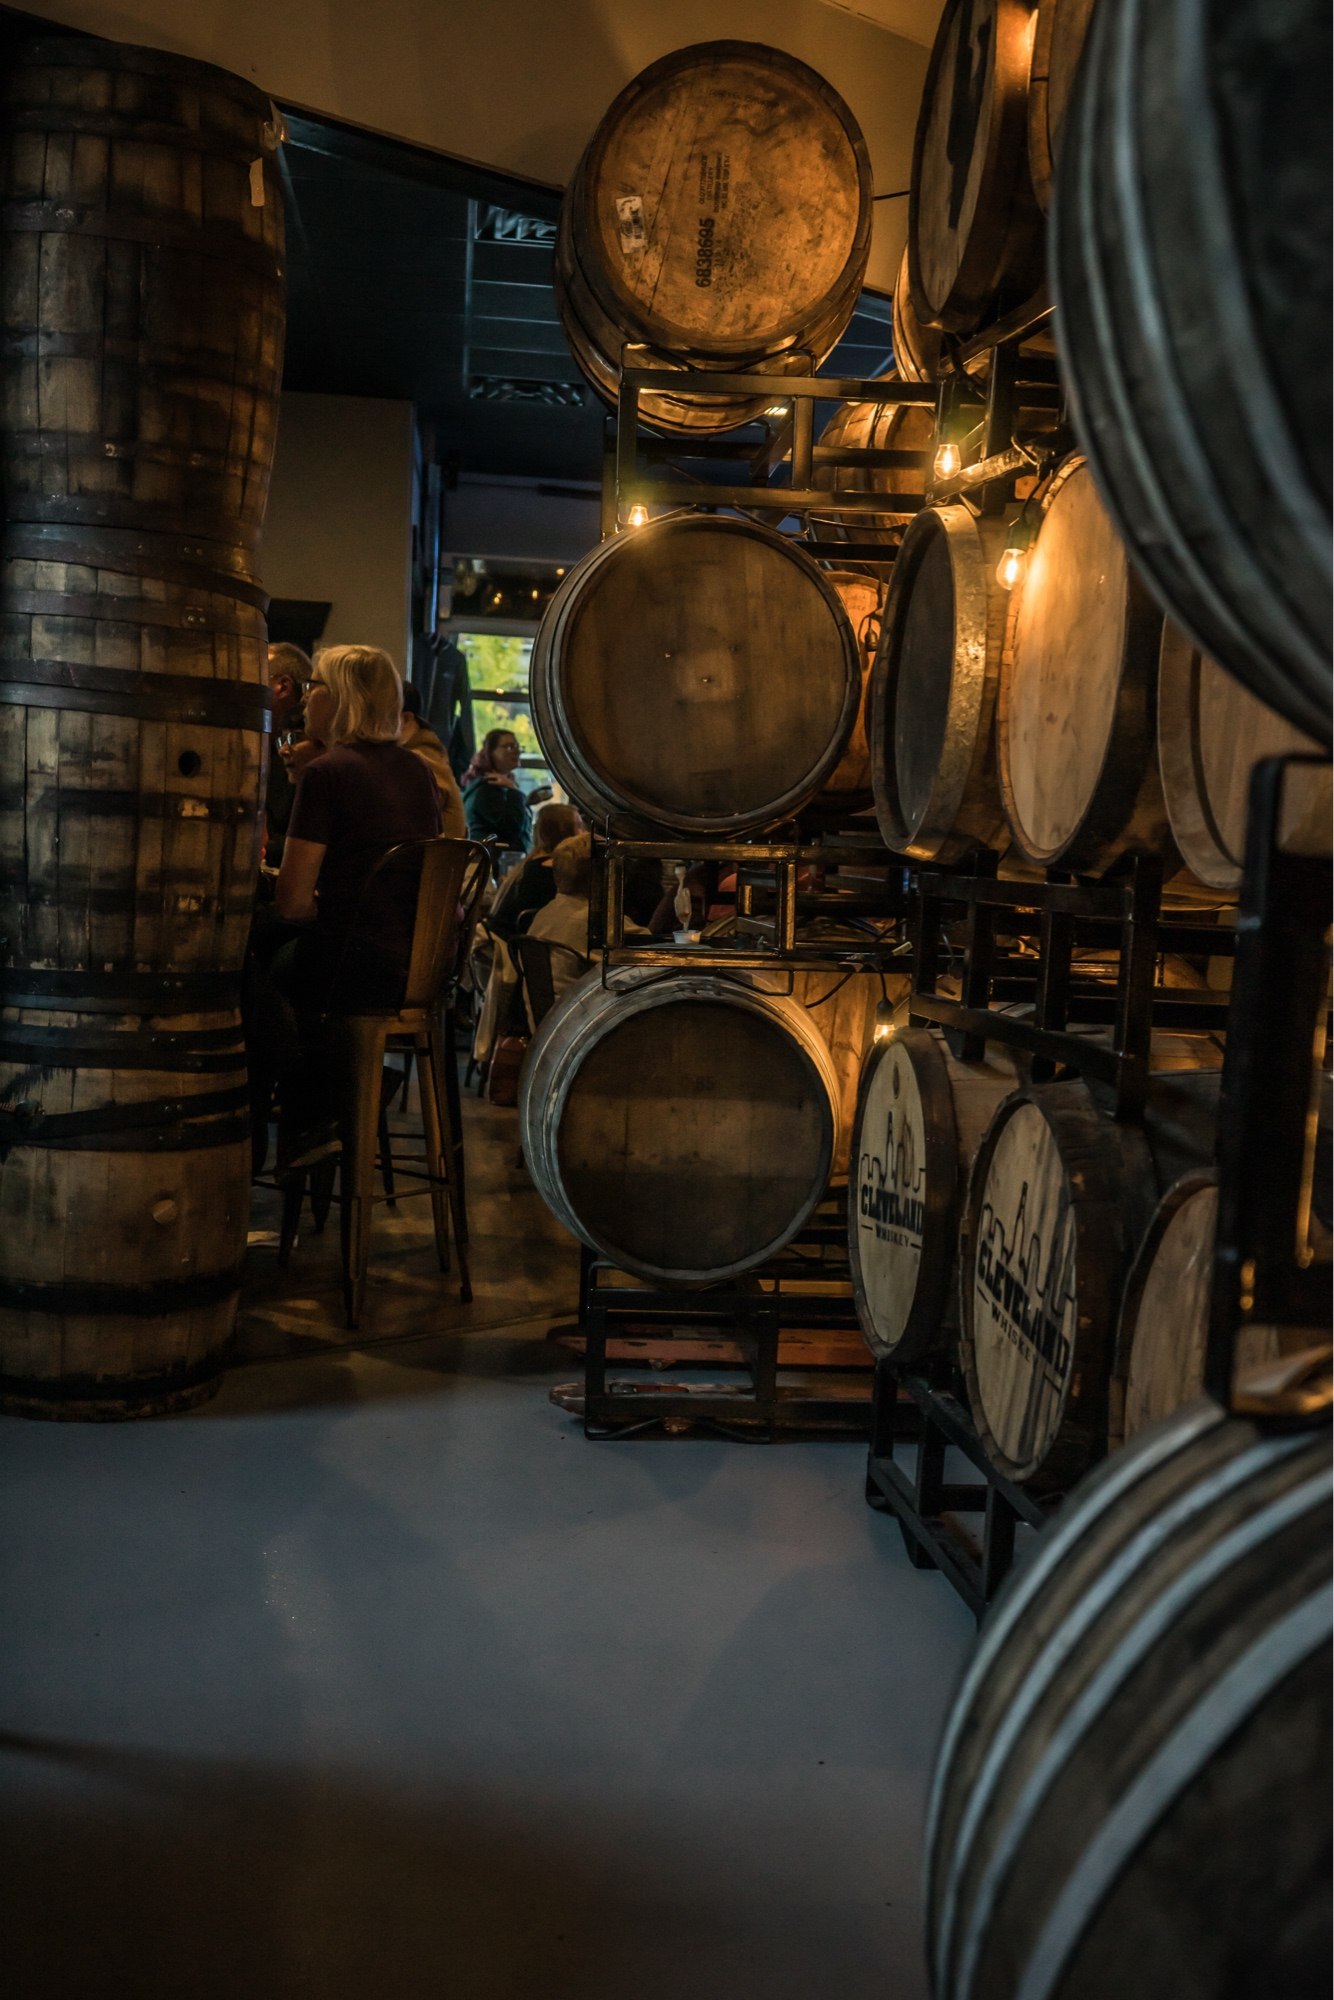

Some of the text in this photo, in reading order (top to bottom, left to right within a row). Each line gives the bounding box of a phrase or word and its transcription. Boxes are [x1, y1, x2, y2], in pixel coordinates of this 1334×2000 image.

[695, 217, 715, 288] 6838695
[861, 1184, 925, 1236] CLEVELAND
[876, 1223, 909, 1248] WHISKEY
[978, 1240, 1069, 1378] CLEVELAND
